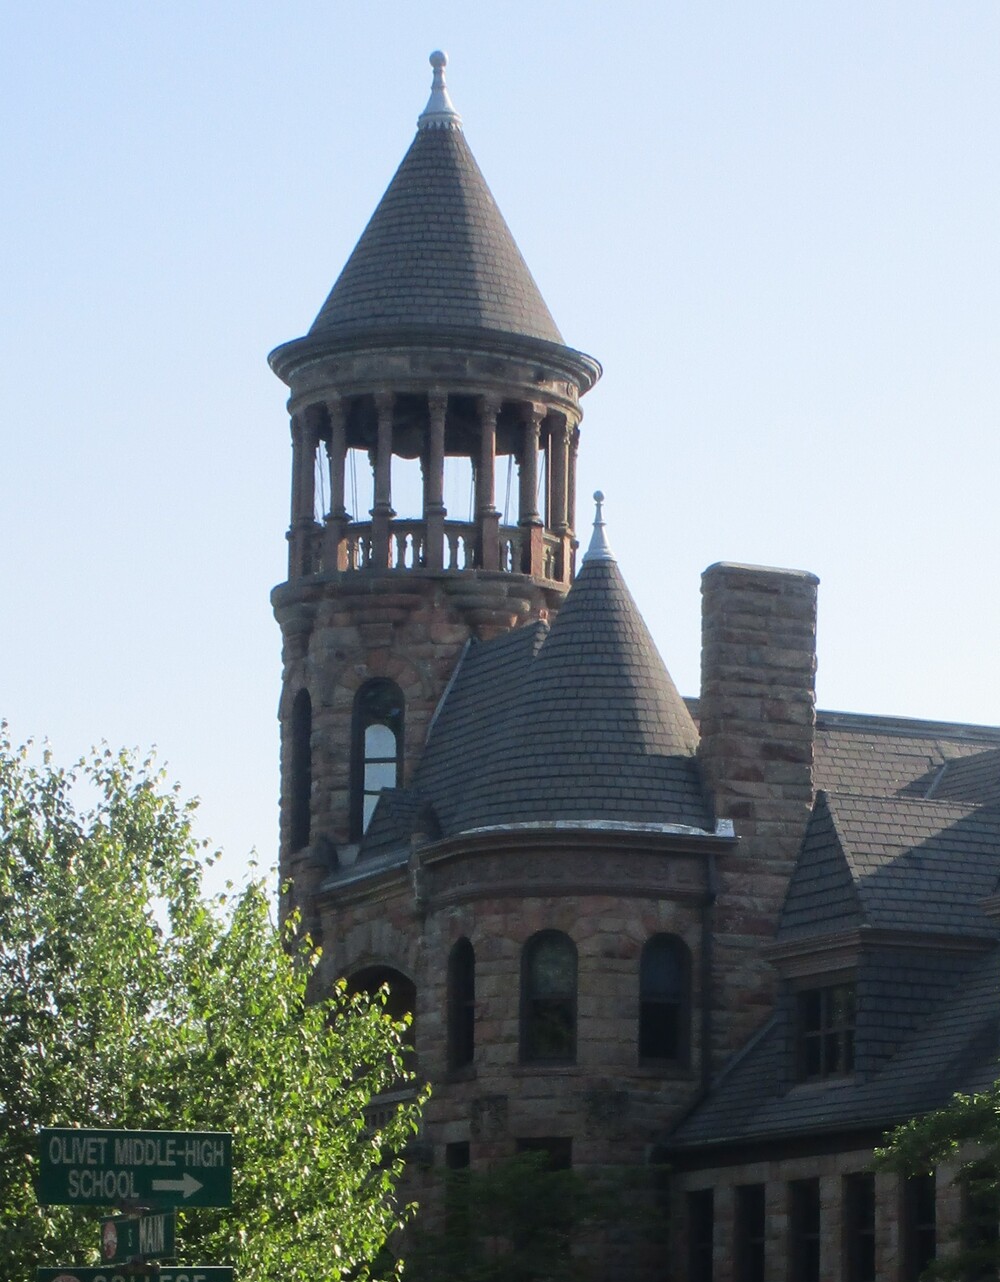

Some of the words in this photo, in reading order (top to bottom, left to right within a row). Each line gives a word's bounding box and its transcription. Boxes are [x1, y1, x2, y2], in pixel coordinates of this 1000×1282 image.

[49, 1136, 107, 1165] OLIVET
[114, 1138, 225, 1167] MIDDLE-HIGH
[68, 1169, 140, 1198] SCHOOL
[139, 1215, 165, 1254] MAIN
